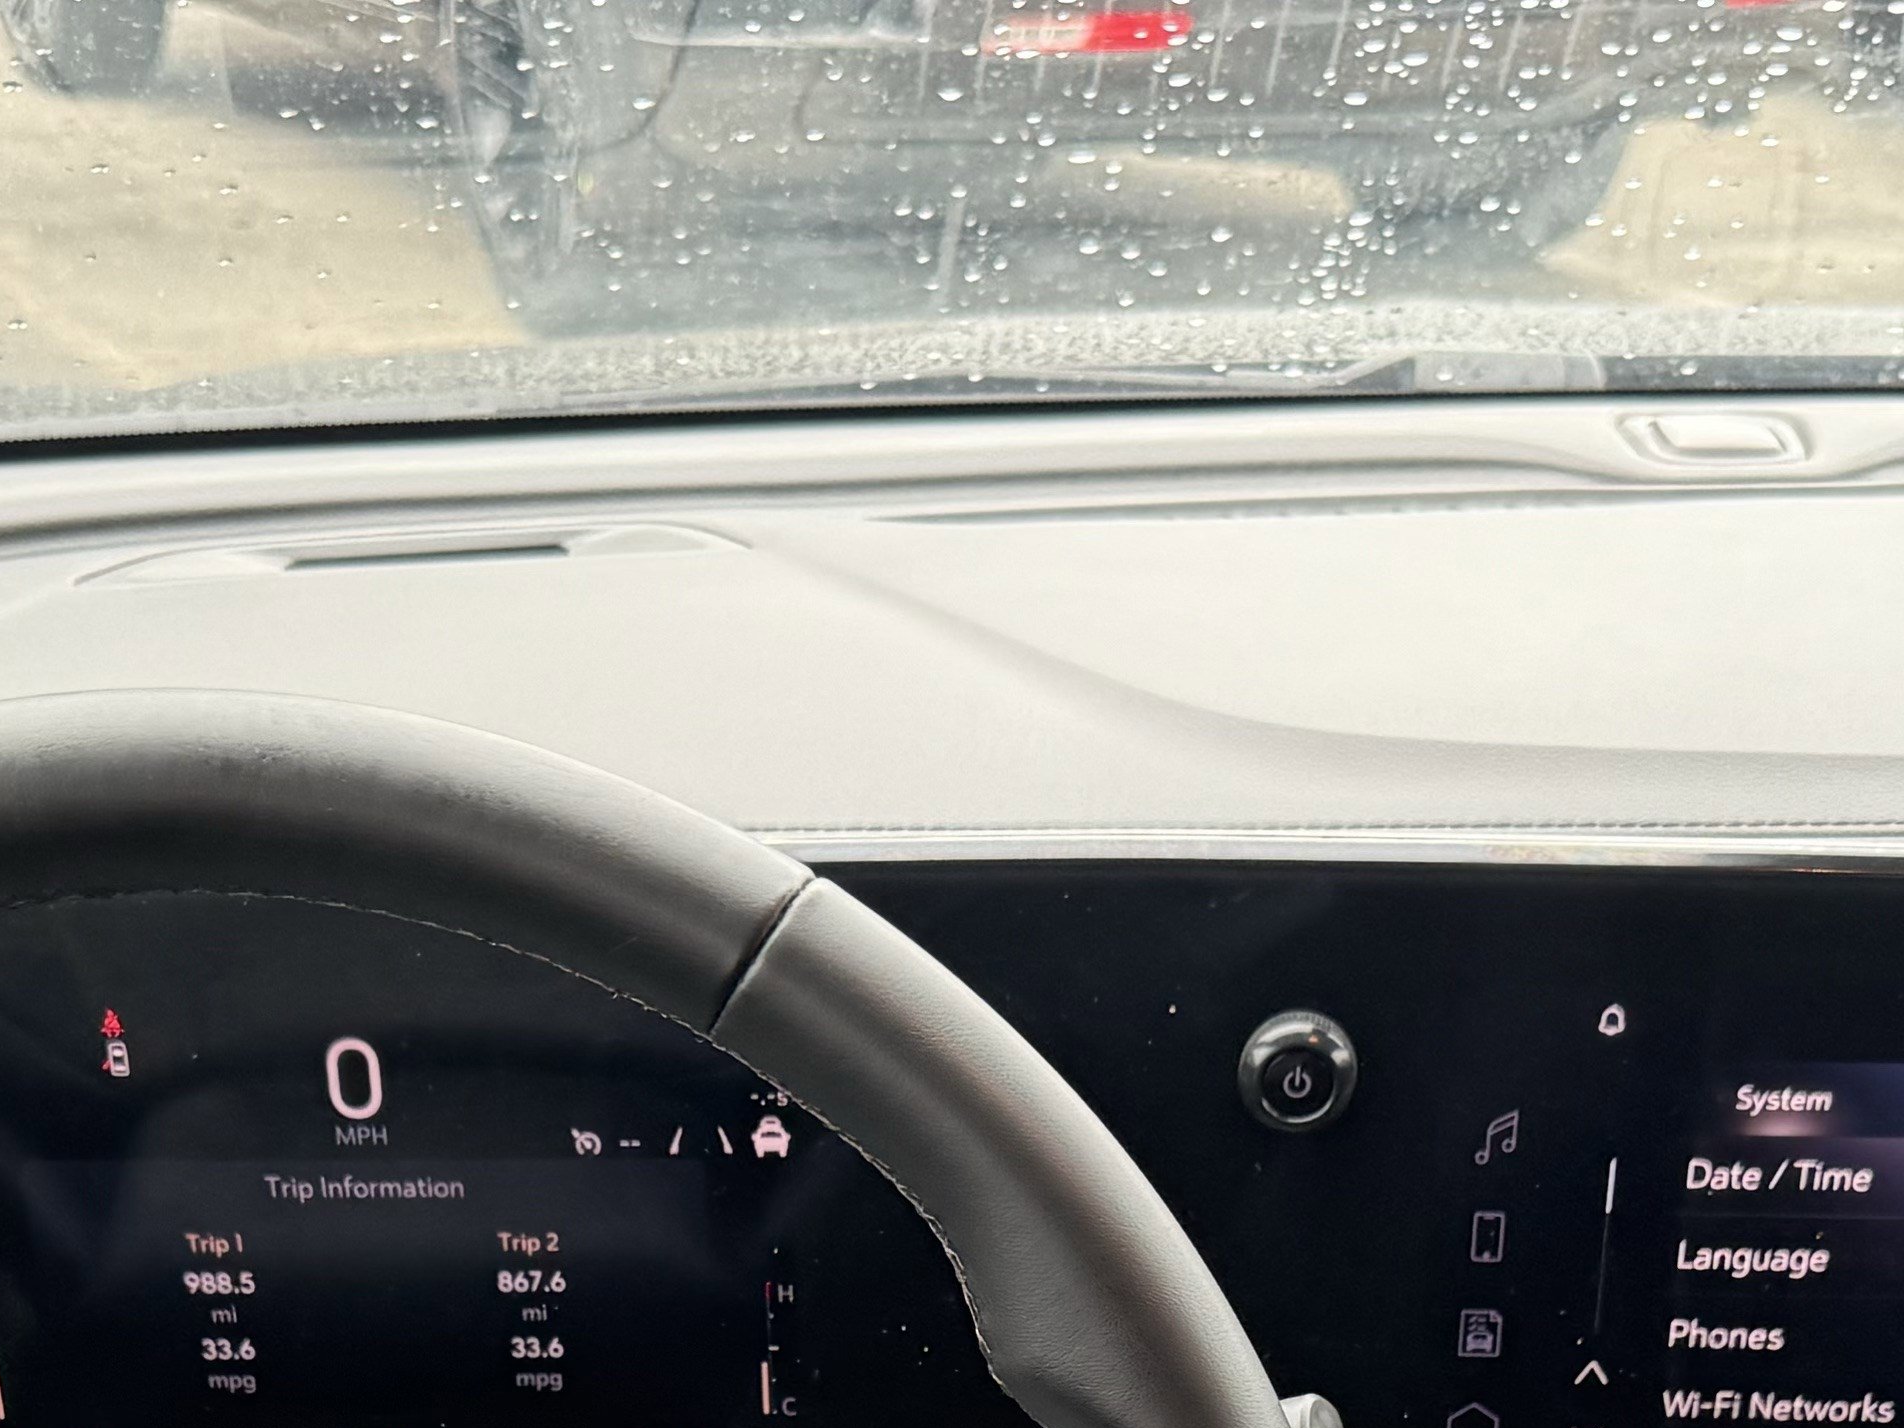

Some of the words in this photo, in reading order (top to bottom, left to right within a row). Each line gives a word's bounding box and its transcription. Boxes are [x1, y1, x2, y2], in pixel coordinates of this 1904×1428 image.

[325, 1037, 383, 1120] 0
[1735, 1084, 1833, 1117] System
[335, 1125, 388, 1146] MPH
[1686, 1157, 1763, 1191] Date
[1768, 1158, 1789, 1190] /
[1793, 1158, 1873, 1193] Time
[263, 1175, 314, 1204] Trip
[320, 1174, 465, 1199] Information
[185, 1232, 230, 1258] Trip
[235, 1232, 243, 1253] 1
[497, 1231, 541, 1256] Trip
[546, 1232, 559, 1252] 2
[1676, 1239, 1830, 1280] Language
[183, 1271, 256, 1295] 988.5
[497, 1270, 567, 1293] 867.6
[777, 1284, 794, 1303] H
[211, 1304, 238, 1323] mi
[521, 1303, 548, 1321] mi
[1667, 1318, 1785, 1351] Phones
[201, 1337, 256, 1361] 33.6
[511, 1336, 565, 1359] 33.6
[207, 1374, 257, 1394] mpg
[515, 1372, 563, 1392] mpg
[781, 1396, 797, 1417] C
[1662, 1389, 1741, 1420] Wi-Fi
[1748, 1391, 1895, 1424] Networks
